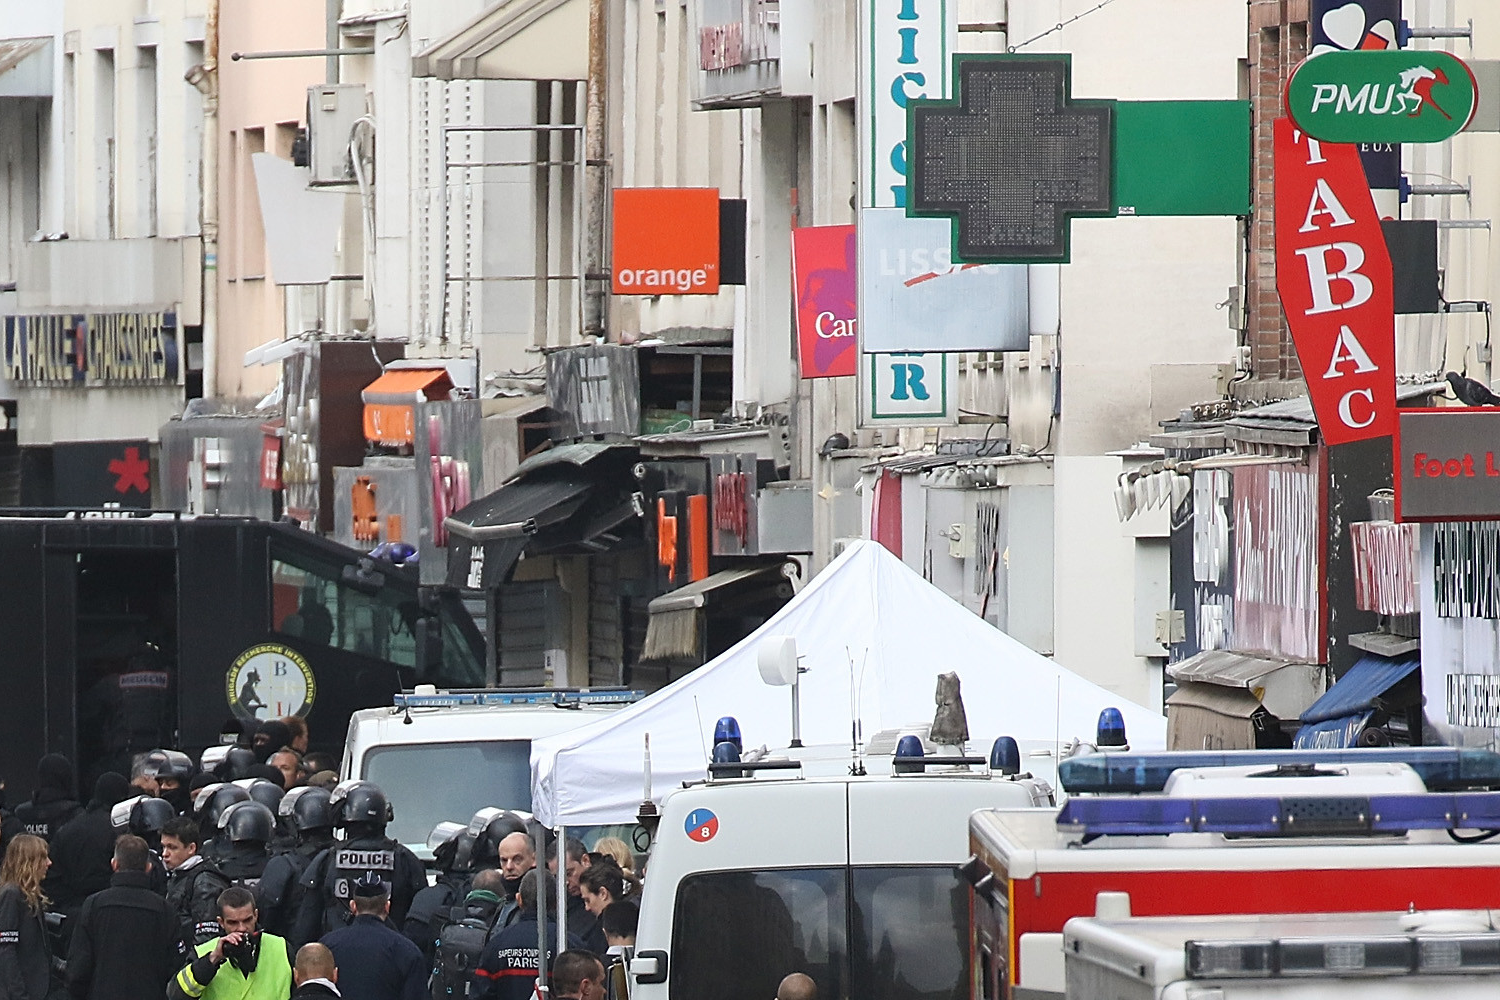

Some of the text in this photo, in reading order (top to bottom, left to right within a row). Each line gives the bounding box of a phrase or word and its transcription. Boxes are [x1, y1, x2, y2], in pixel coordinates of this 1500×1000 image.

[1311, 83, 1396, 115] PMU
[1360, 142, 1394, 153] EUX
[879, 247, 1000, 276] LISS
[619, 268, 707, 291] orange
[1293, 129, 1380, 429] TABAC
[1414, 452, 1477, 478] Foot
[24, 823, 49, 835] OLICE
[701, 826, 711, 838] 8
[339, 853, 391, 866] POLICE
[498, 948, 522, 959] SAPEURS
[508, 957, 539, 969] PARIS
